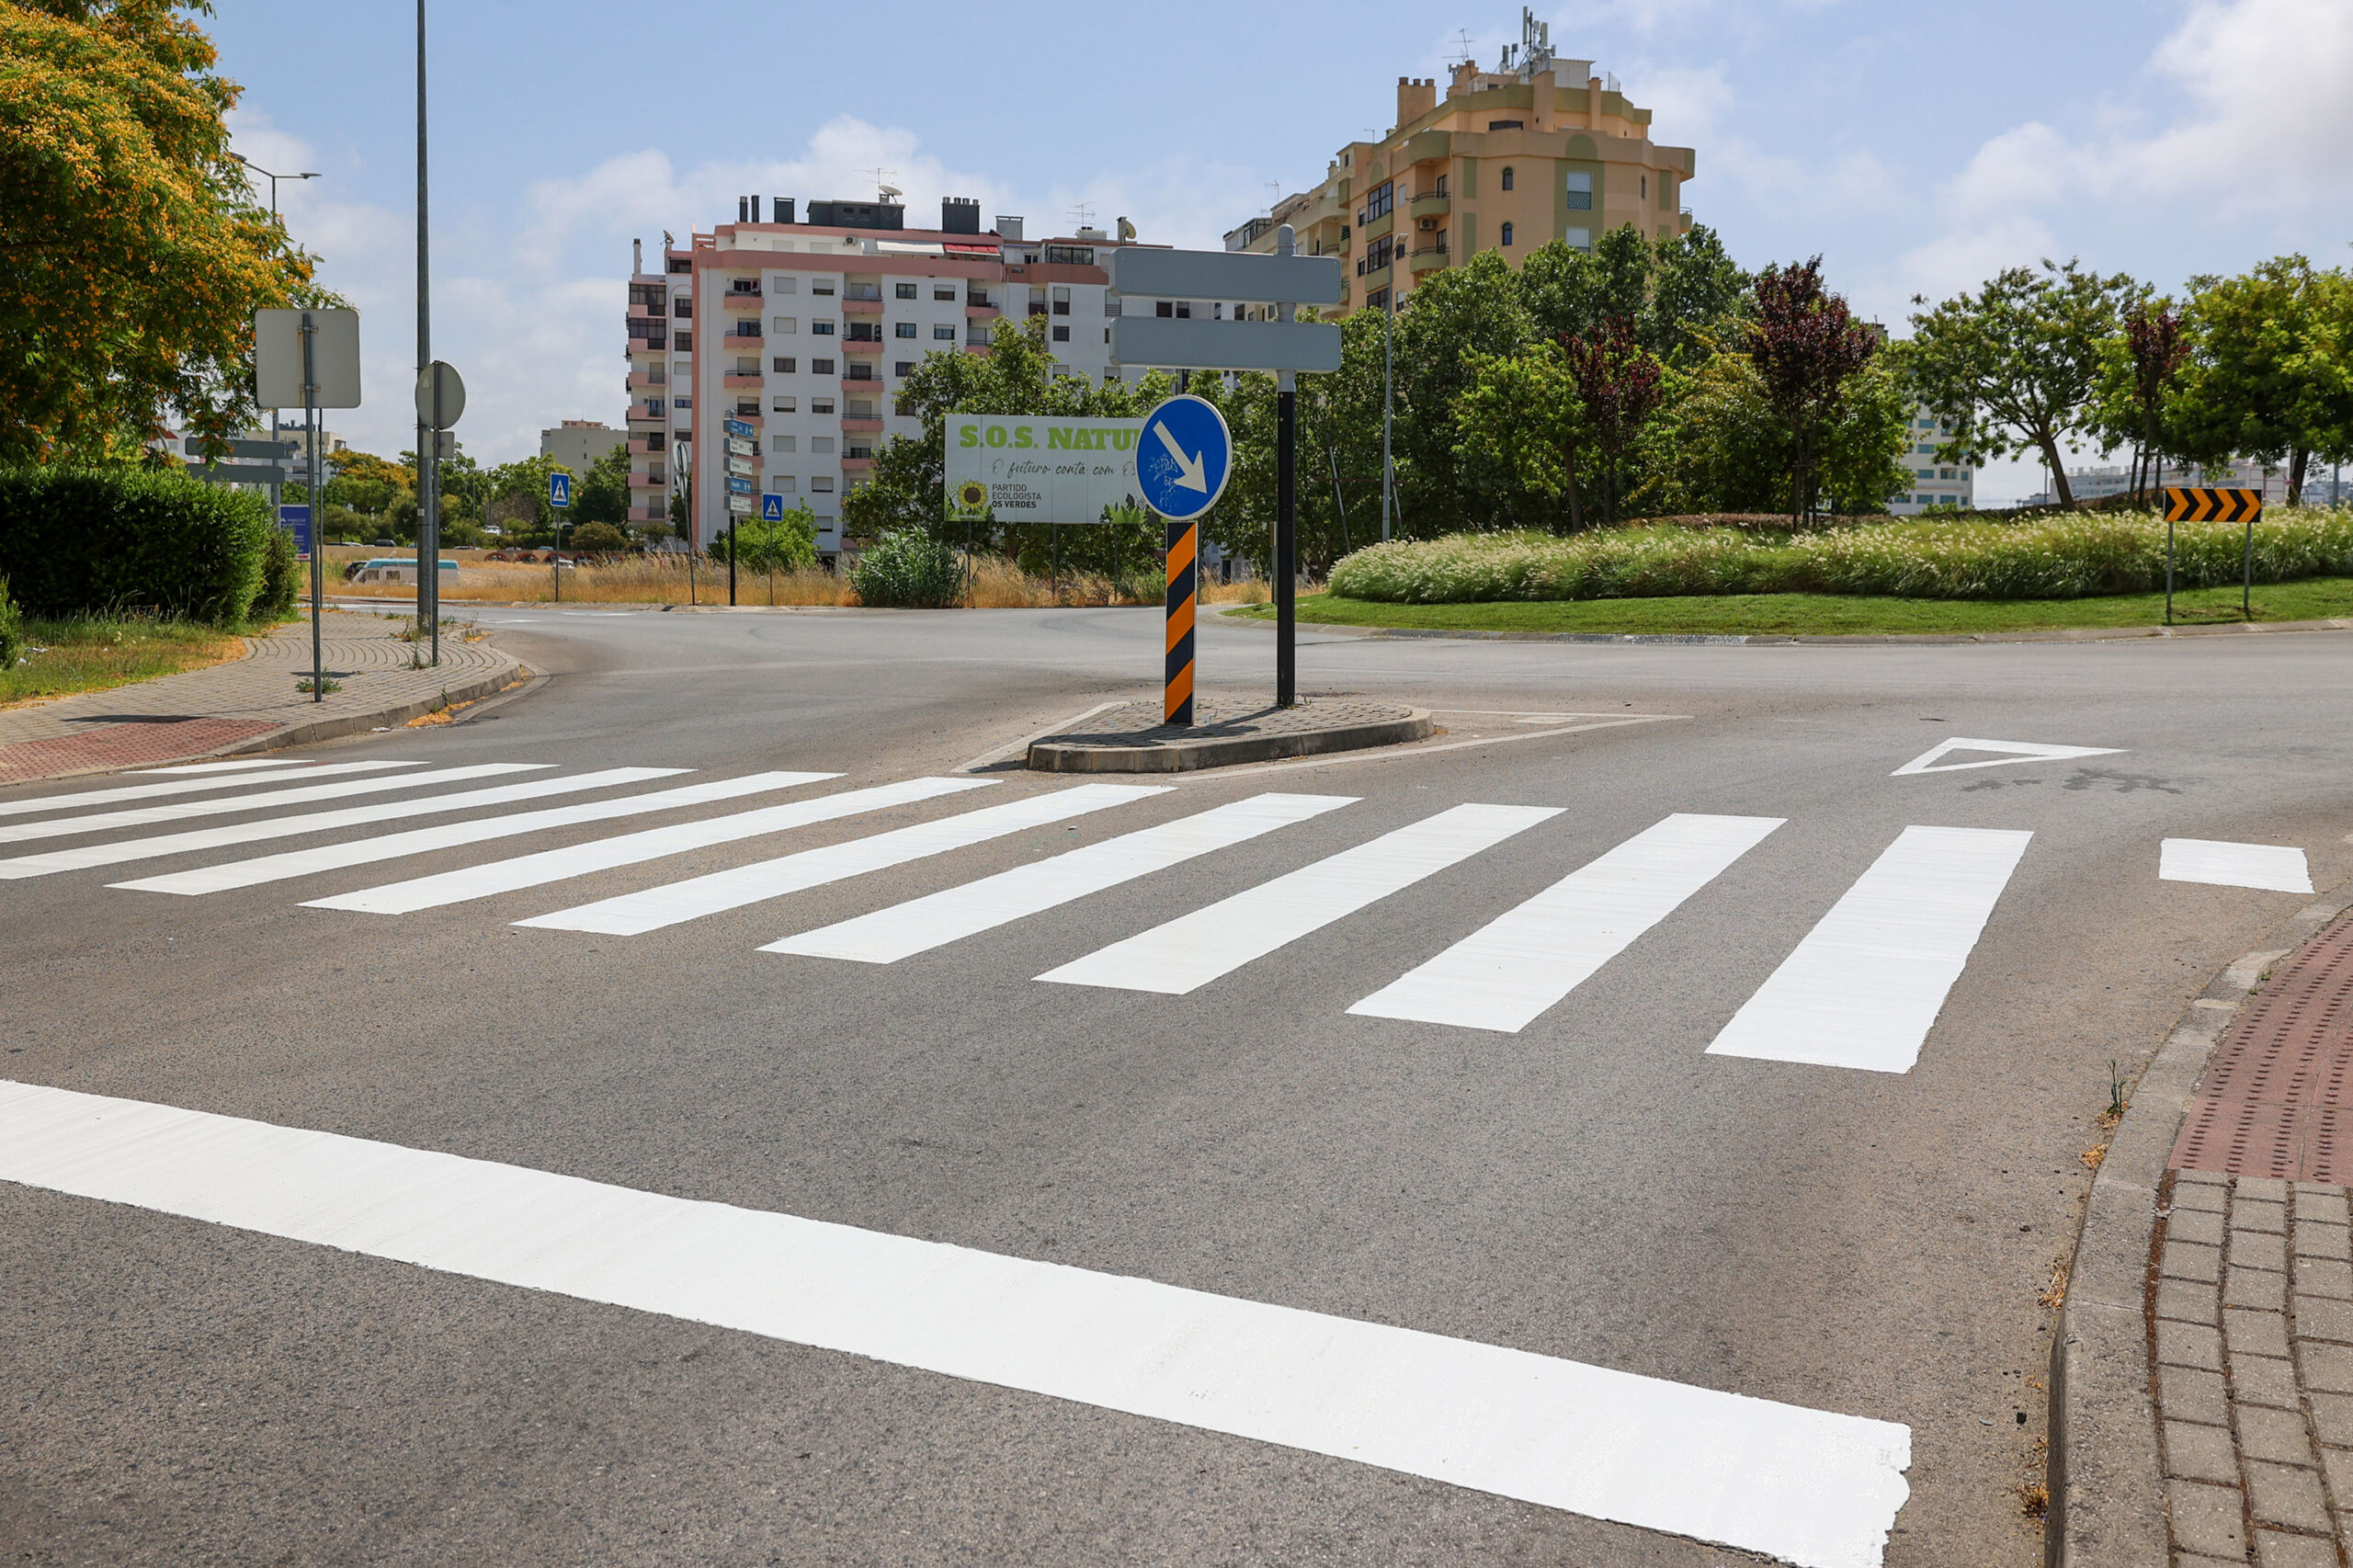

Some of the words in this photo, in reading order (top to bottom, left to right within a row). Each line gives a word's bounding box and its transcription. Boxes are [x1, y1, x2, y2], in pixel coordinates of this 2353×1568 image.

[960, 425, 1039, 449] S.O.S.
[992, 458, 1005, 474] O
[1007, 459, 1051, 479] futuro
[1054, 460, 1087, 475] conta
[1092, 463, 1116, 476] com
[992, 483, 1028, 493] PARTIDO
[992, 492, 1042, 501] ECOLOGISTA
[992, 500, 1003, 508] OS
[1005, 500, 1037, 508] VERDES
